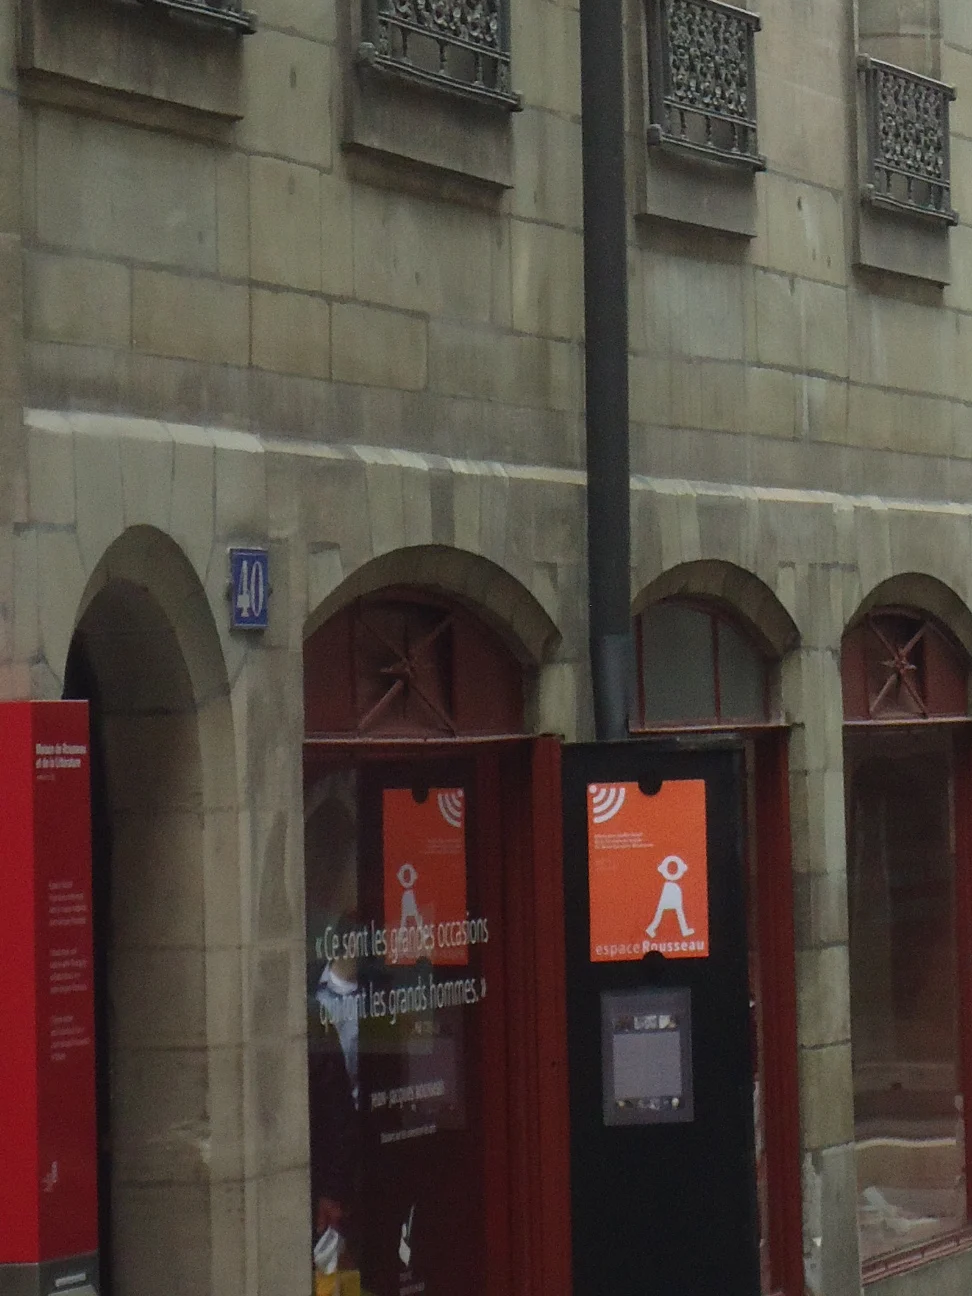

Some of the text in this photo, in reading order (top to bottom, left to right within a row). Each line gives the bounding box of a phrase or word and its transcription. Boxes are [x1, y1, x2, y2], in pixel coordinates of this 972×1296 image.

[236, 560, 264, 617] 40
[342, 925, 369, 958] sont
[371, 920, 387, 955] les
[390, 920, 435, 964] grandes
[438, 912, 489, 948] occasions
[370, 982, 386, 1017] les
[389, 975, 427, 1025] grands
[430, 973, 478, 1008] hommes.
